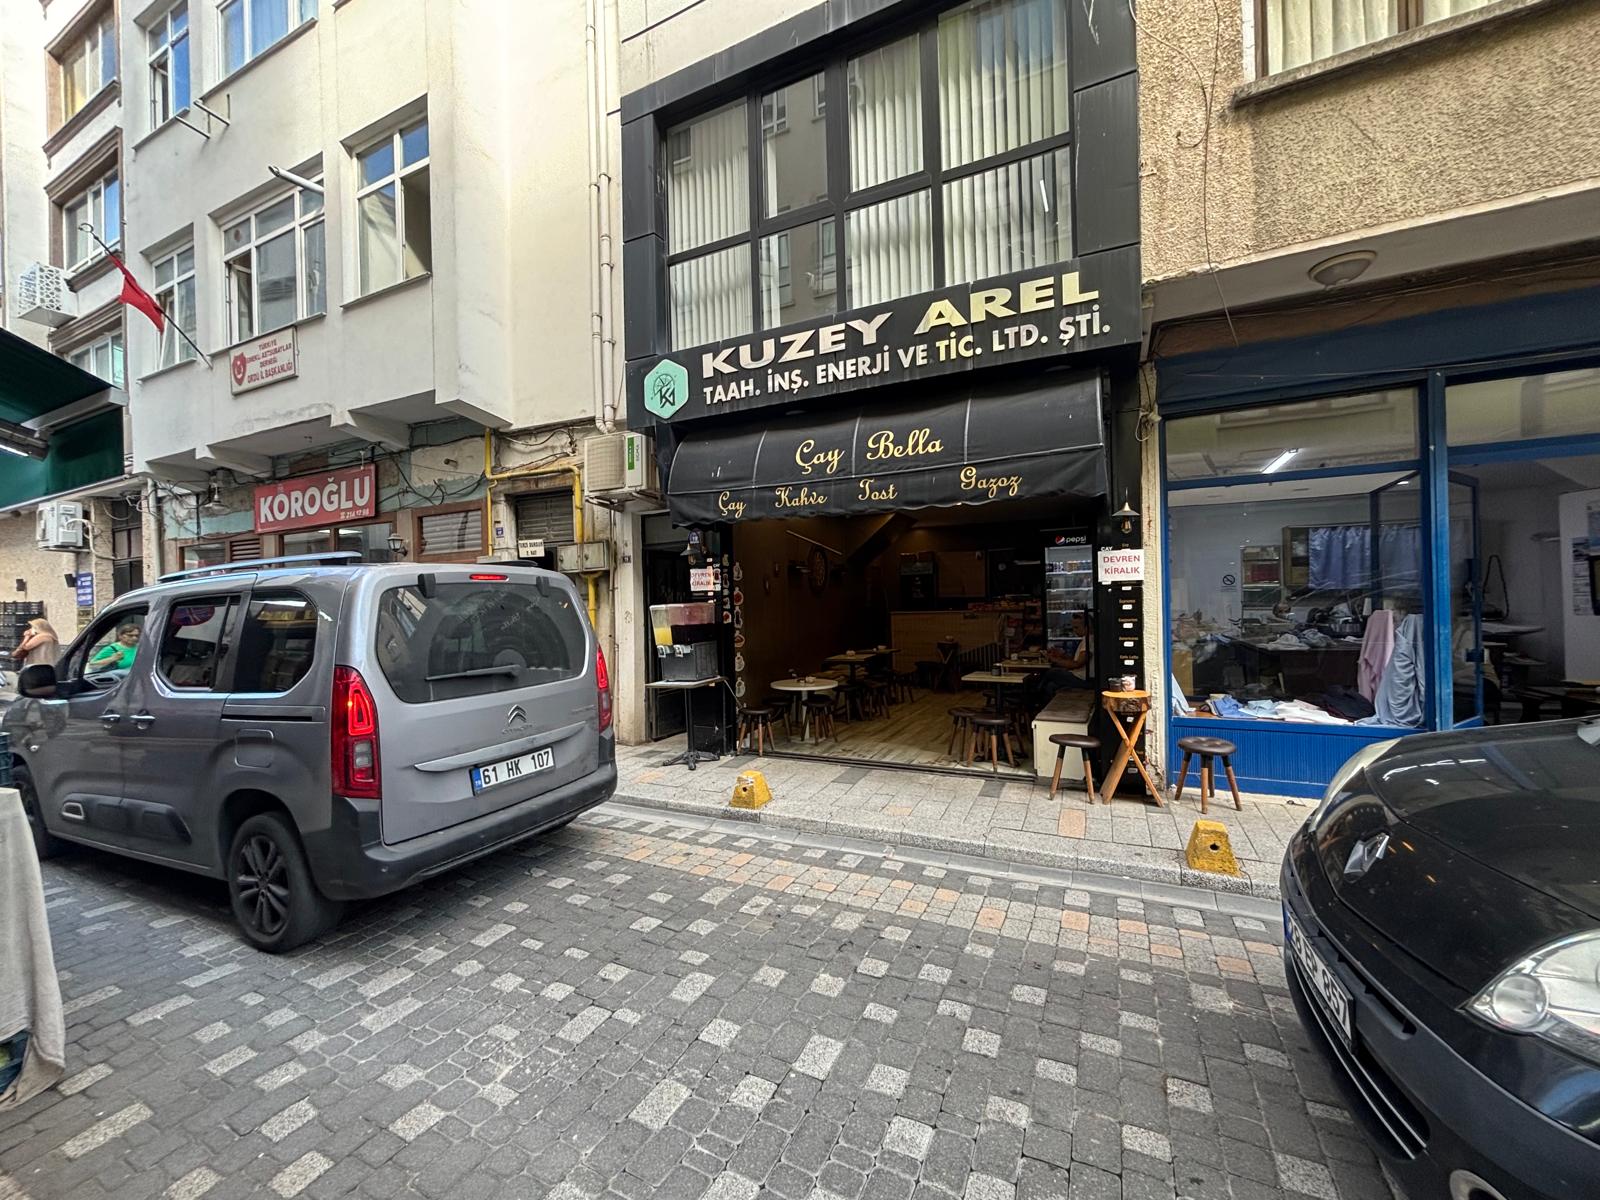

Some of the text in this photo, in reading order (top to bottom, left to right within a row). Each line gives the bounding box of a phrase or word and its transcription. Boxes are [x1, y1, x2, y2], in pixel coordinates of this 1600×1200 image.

[702, 271, 1099, 379] KUZEY AREL
[703, 304, 1111, 405] TAAH. İNŞ. ENERJİ VE TİC. LTD. ŞTİ.
[795, 427, 945, 475] Çay Bella
[718, 466, 1023, 519] Çay Kahve Tost Gazoz
[1065, 535, 1087, 544] pepsi
[1103, 555, 1140, 563] DEVREN
[1104, 567, 1140, 575] KİRALIK
[482, 750, 550, 785] 61 HK 107
[1322, 968, 1347, 1027] 857
